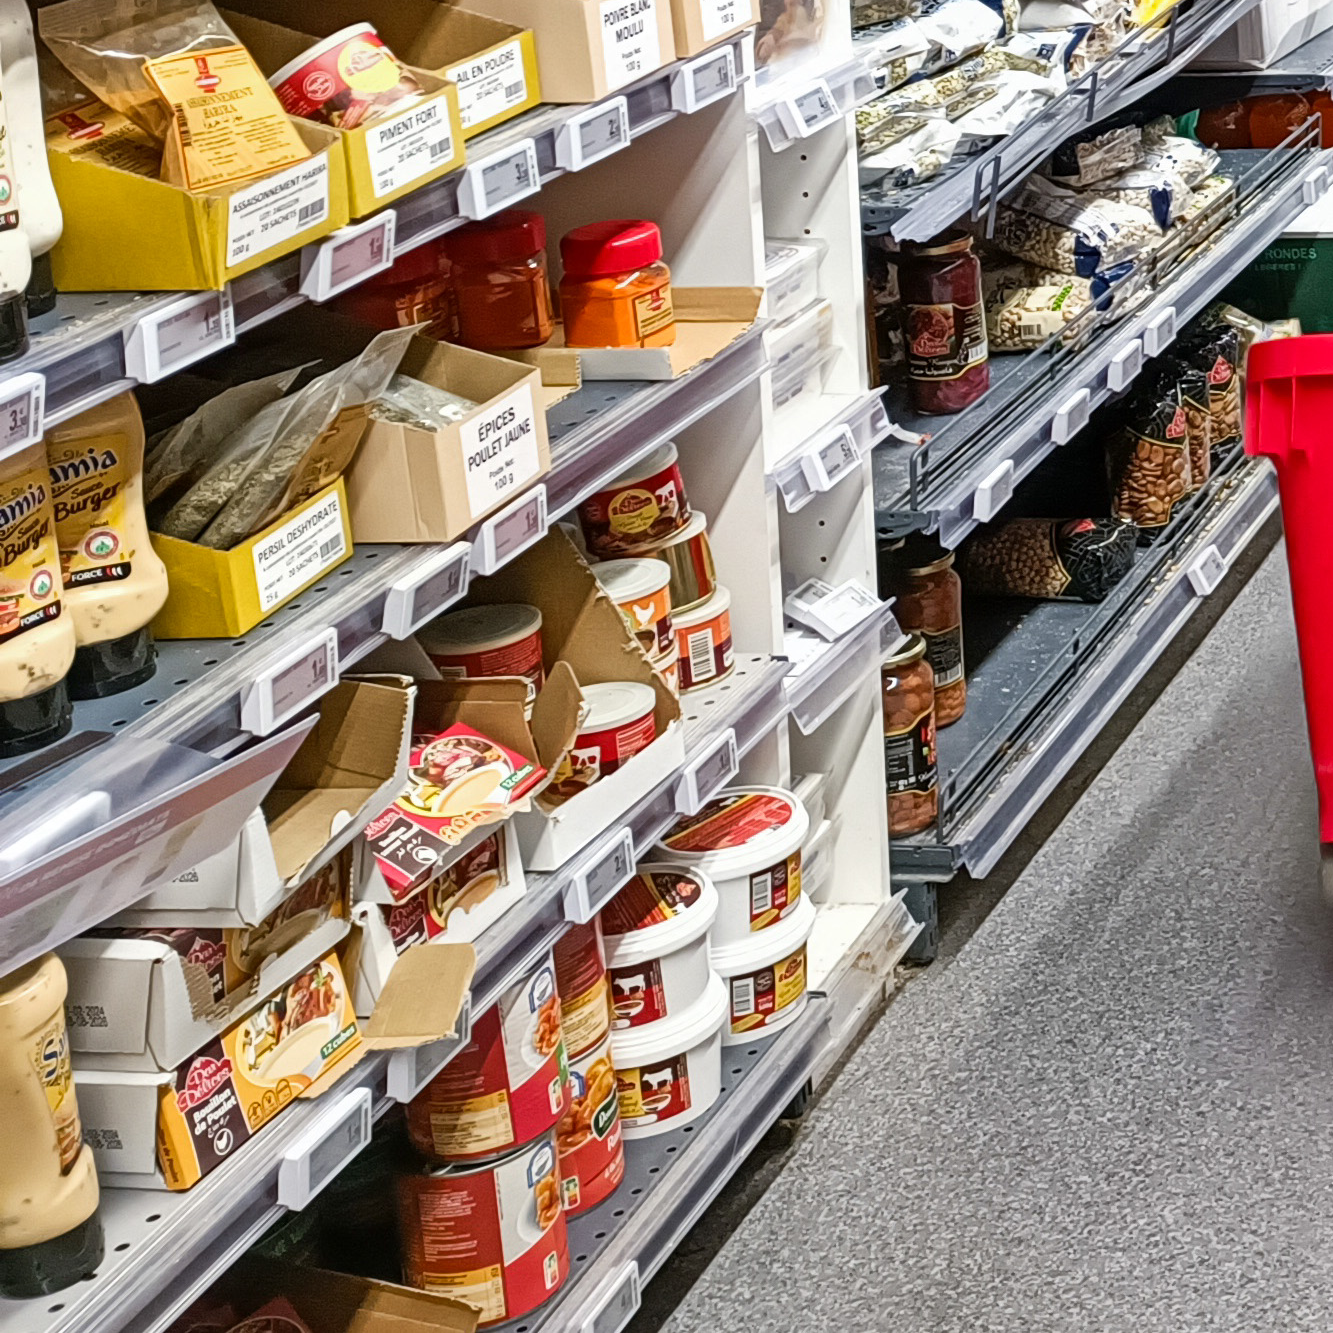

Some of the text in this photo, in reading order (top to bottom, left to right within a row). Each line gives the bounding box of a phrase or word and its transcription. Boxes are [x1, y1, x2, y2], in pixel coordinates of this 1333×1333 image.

[604, 7, 629, 27] POIVRE
[615, 19, 644, 42] MOULU
[473, 67, 483, 78] EN
[484, 49, 515, 75] POUDRE
[380, 105, 438, 143] PIMENT FORT
[233, 164, 327, 214] ASSAISONNEMENT HARIRA
[478, 407, 516, 439] ÉPICES
[468, 419, 531, 474] POULET JAUNE
[54, 482, 120, 522] Burger
[71, 481, 103, 499] Sauce
[4, 518, 49, 566] Burger
[257, 501, 338, 565] PERSIL DESHYDRATE
[72, 568, 102, 581] FORCE
[21, 610, 44, 627] FORCE
[322, 1025, 354, 1056] 12 cubes
[193, 1087, 231, 1122] Bouillon
[195, 1097, 237, 1133] de Poulet
